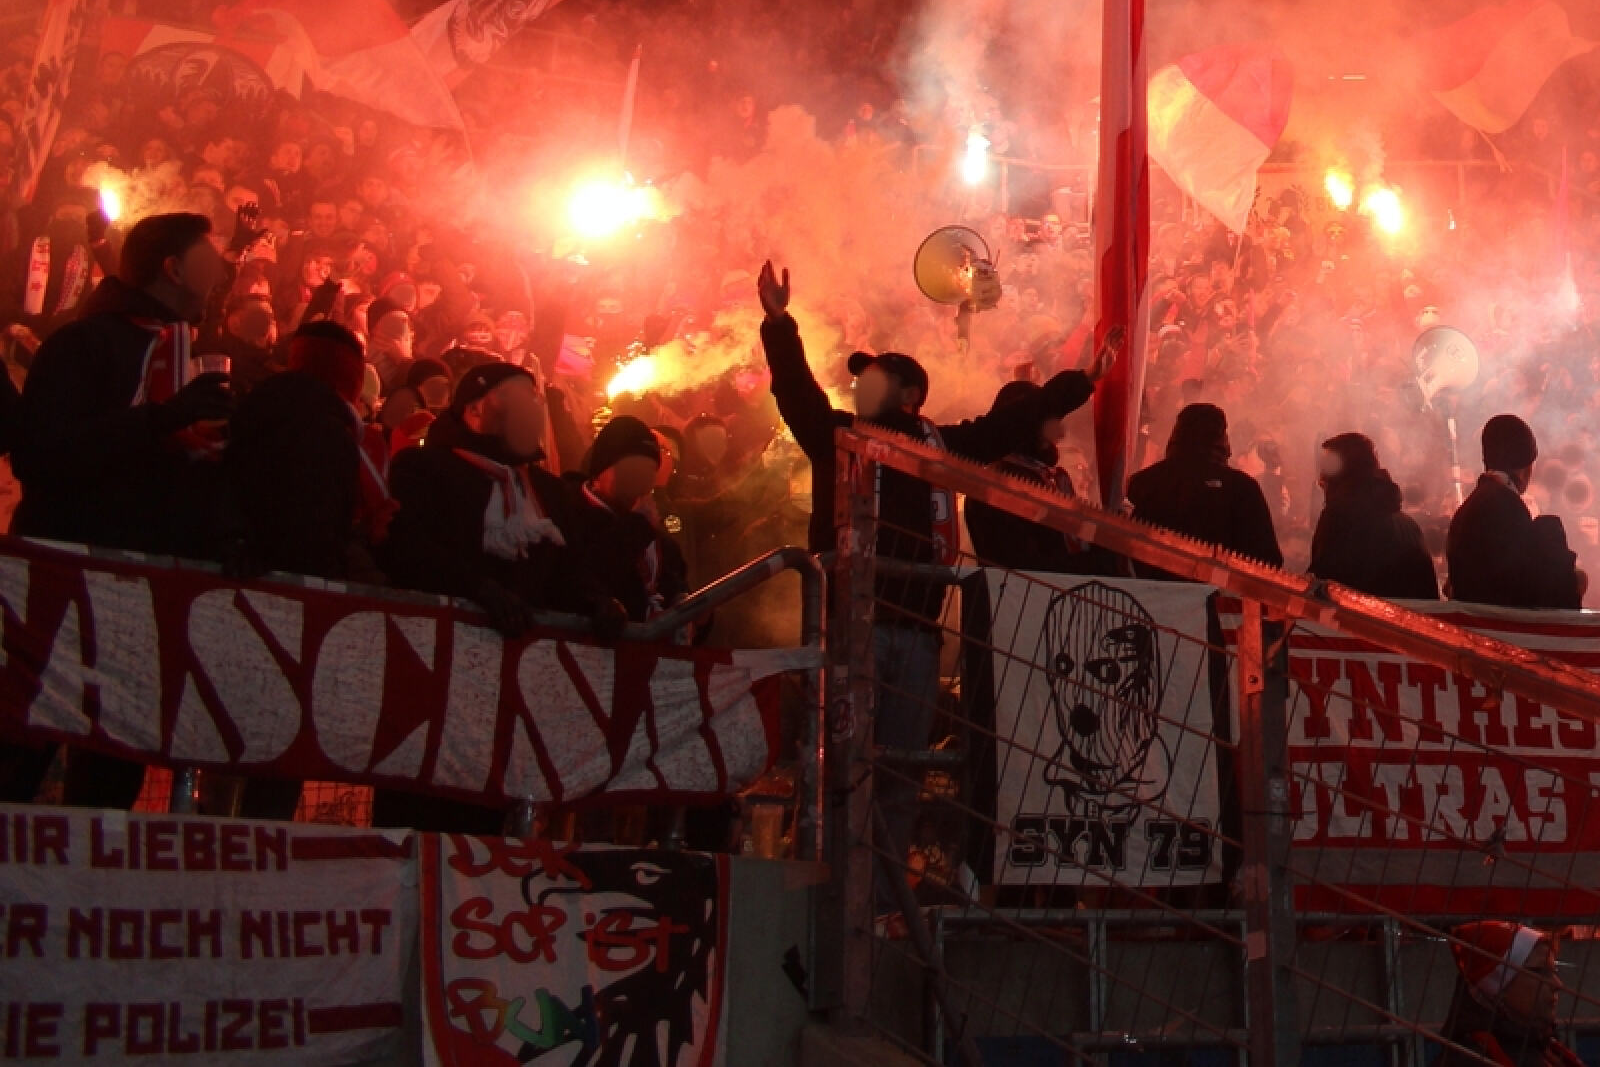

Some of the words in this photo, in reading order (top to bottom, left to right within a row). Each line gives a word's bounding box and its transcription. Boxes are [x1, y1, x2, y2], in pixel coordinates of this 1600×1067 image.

[0, 813, 69, 864] IR
[91, 817, 288, 871] LIEBEN
[1009, 812, 1127, 871] SYN
[1144, 817, 1214, 871] 79
[68, 907, 222, 959] NOCH
[241, 909, 392, 959] NICHT
[3, 1002, 64, 1058] IE
[84, 999, 305, 1057] POLIZEI
